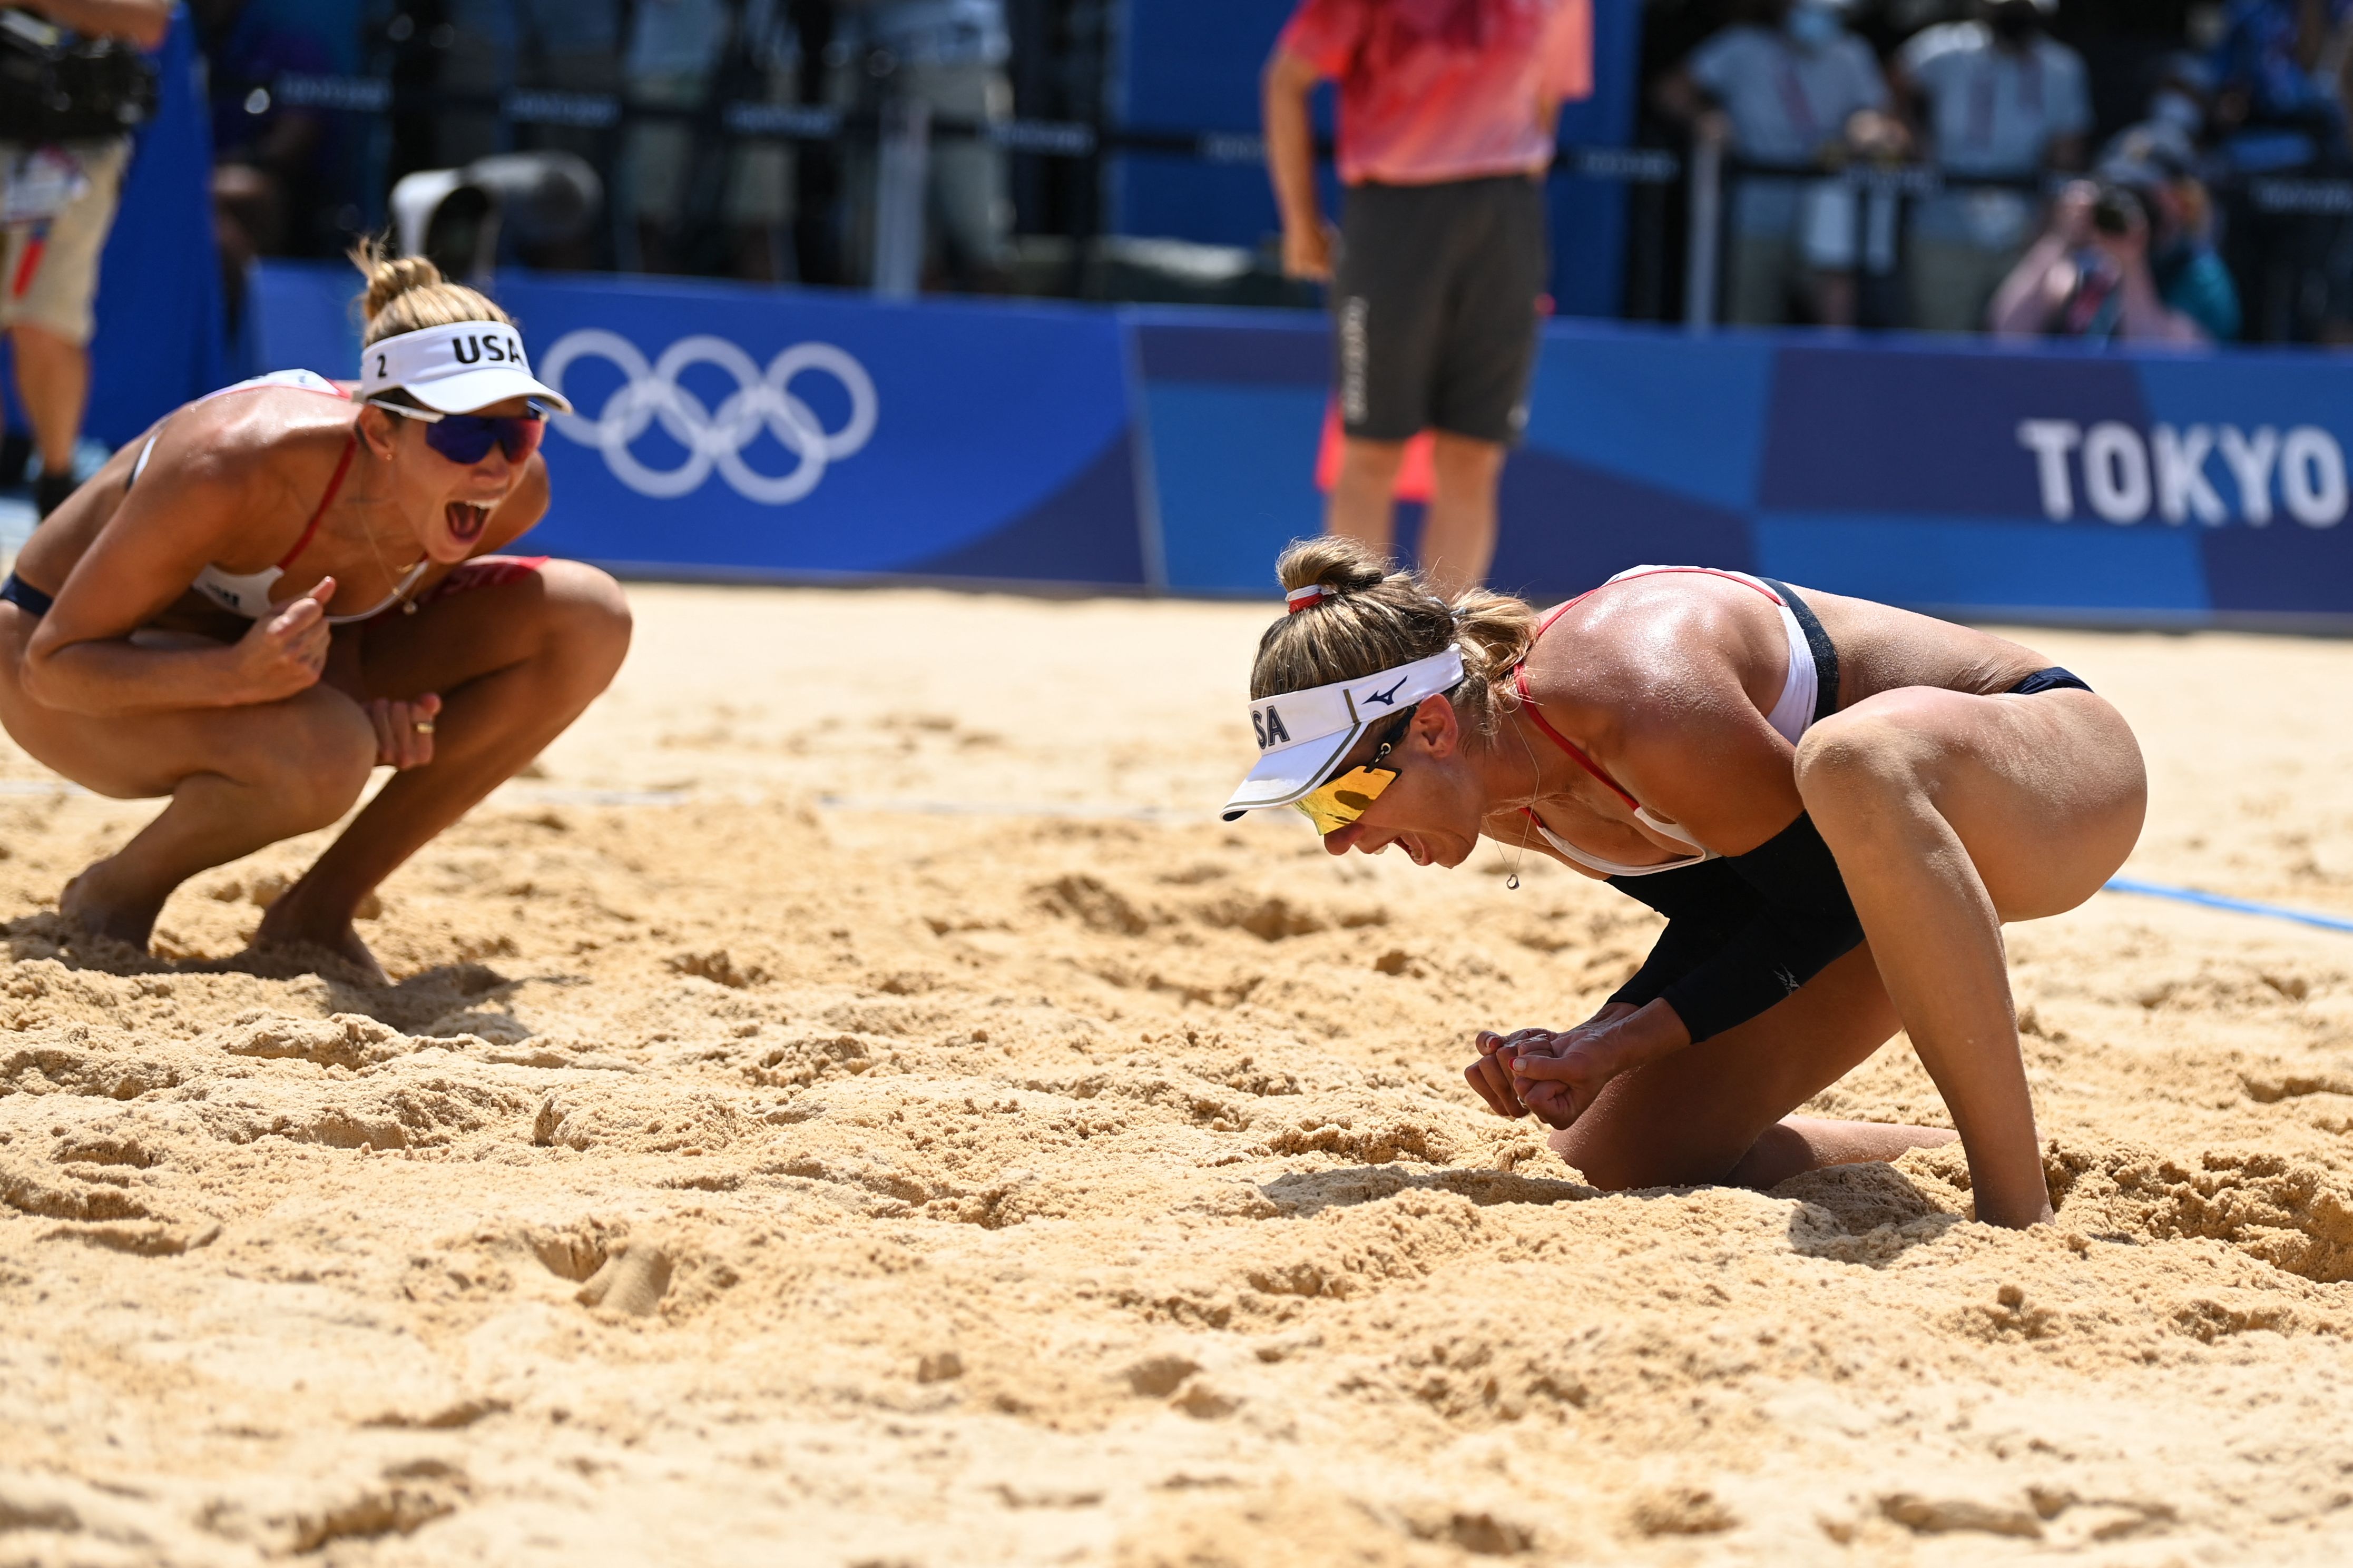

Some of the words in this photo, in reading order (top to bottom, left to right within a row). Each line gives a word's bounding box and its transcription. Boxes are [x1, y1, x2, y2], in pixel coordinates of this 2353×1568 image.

[377, 353, 387, 378] 2
[452, 335, 522, 364] USA
[2015, 418, 2348, 527] TOKYO
[1251, 705, 1290, 750] SA
